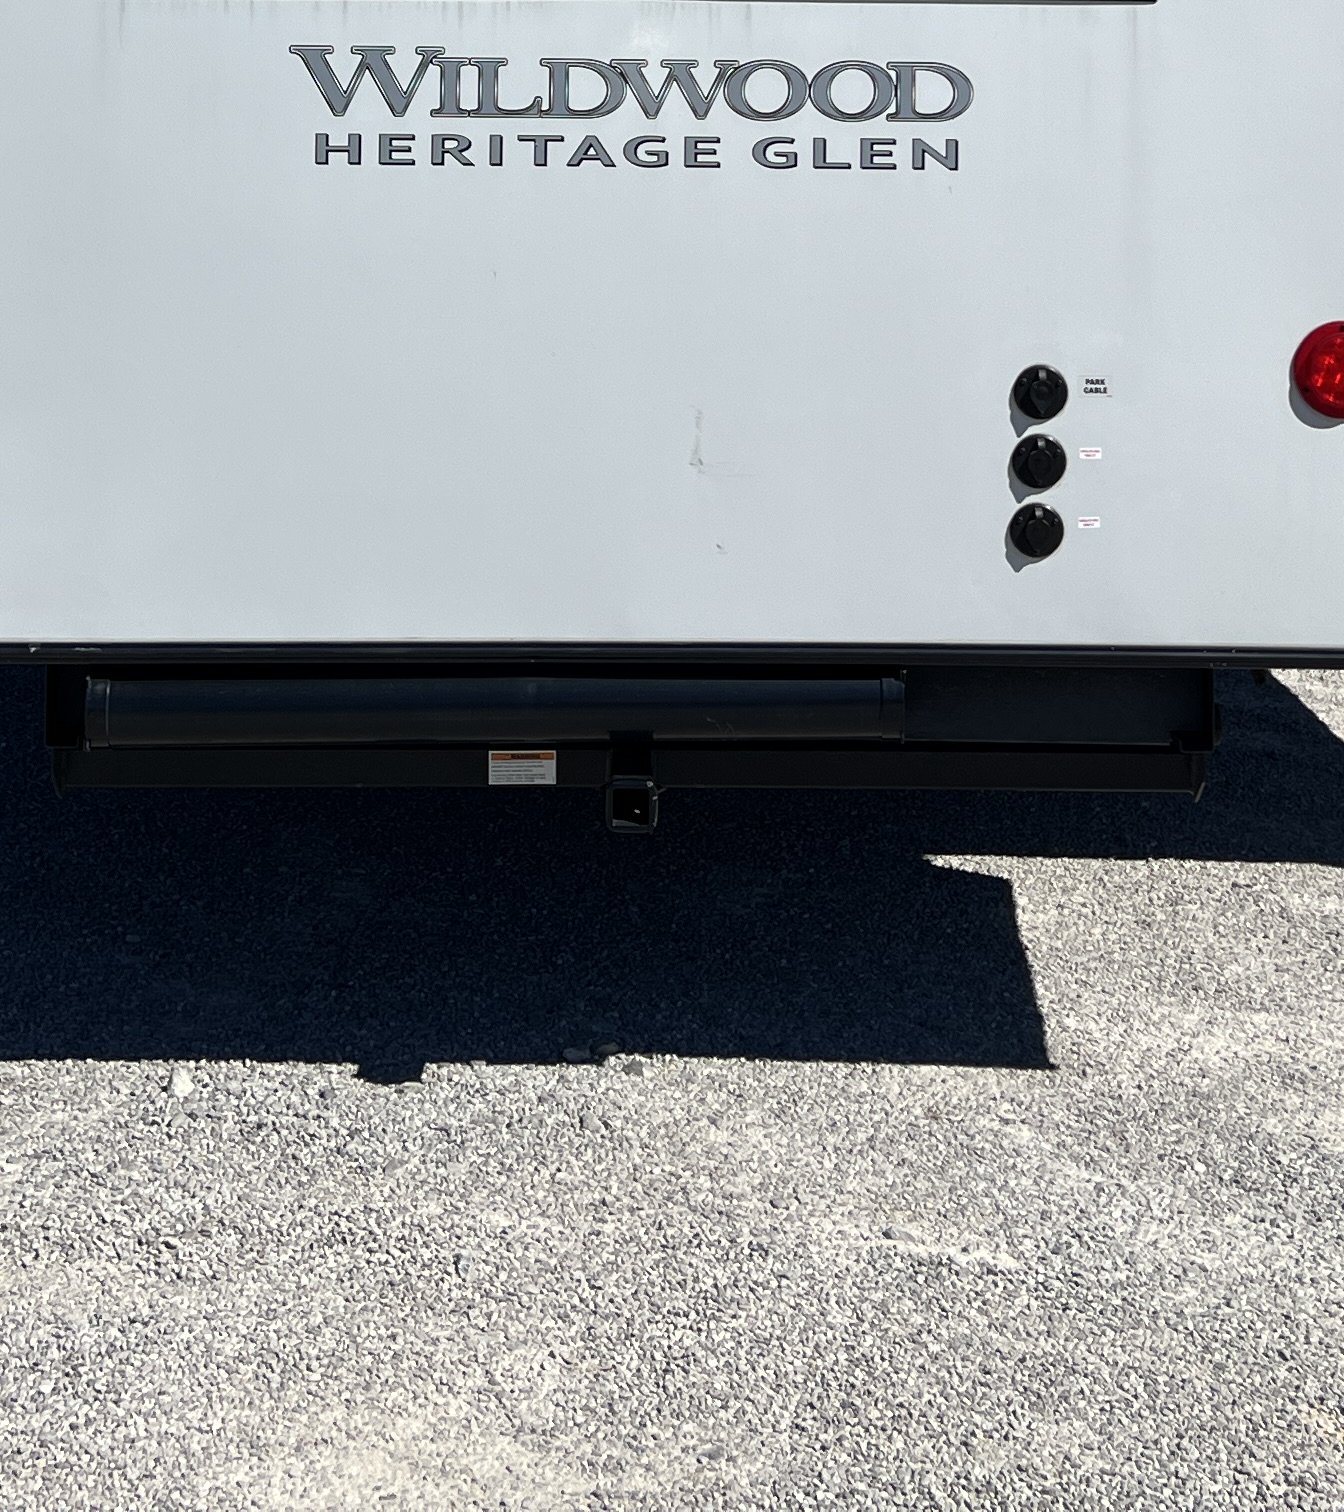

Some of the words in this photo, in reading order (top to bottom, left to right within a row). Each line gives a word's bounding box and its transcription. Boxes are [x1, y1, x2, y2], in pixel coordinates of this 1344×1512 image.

[289, 43, 976, 123] WILDWOOD
[313, 132, 722, 169] HERITAGE
[750, 136, 960, 171] GLEN
[1083, 386, 1108, 394] CABLE
